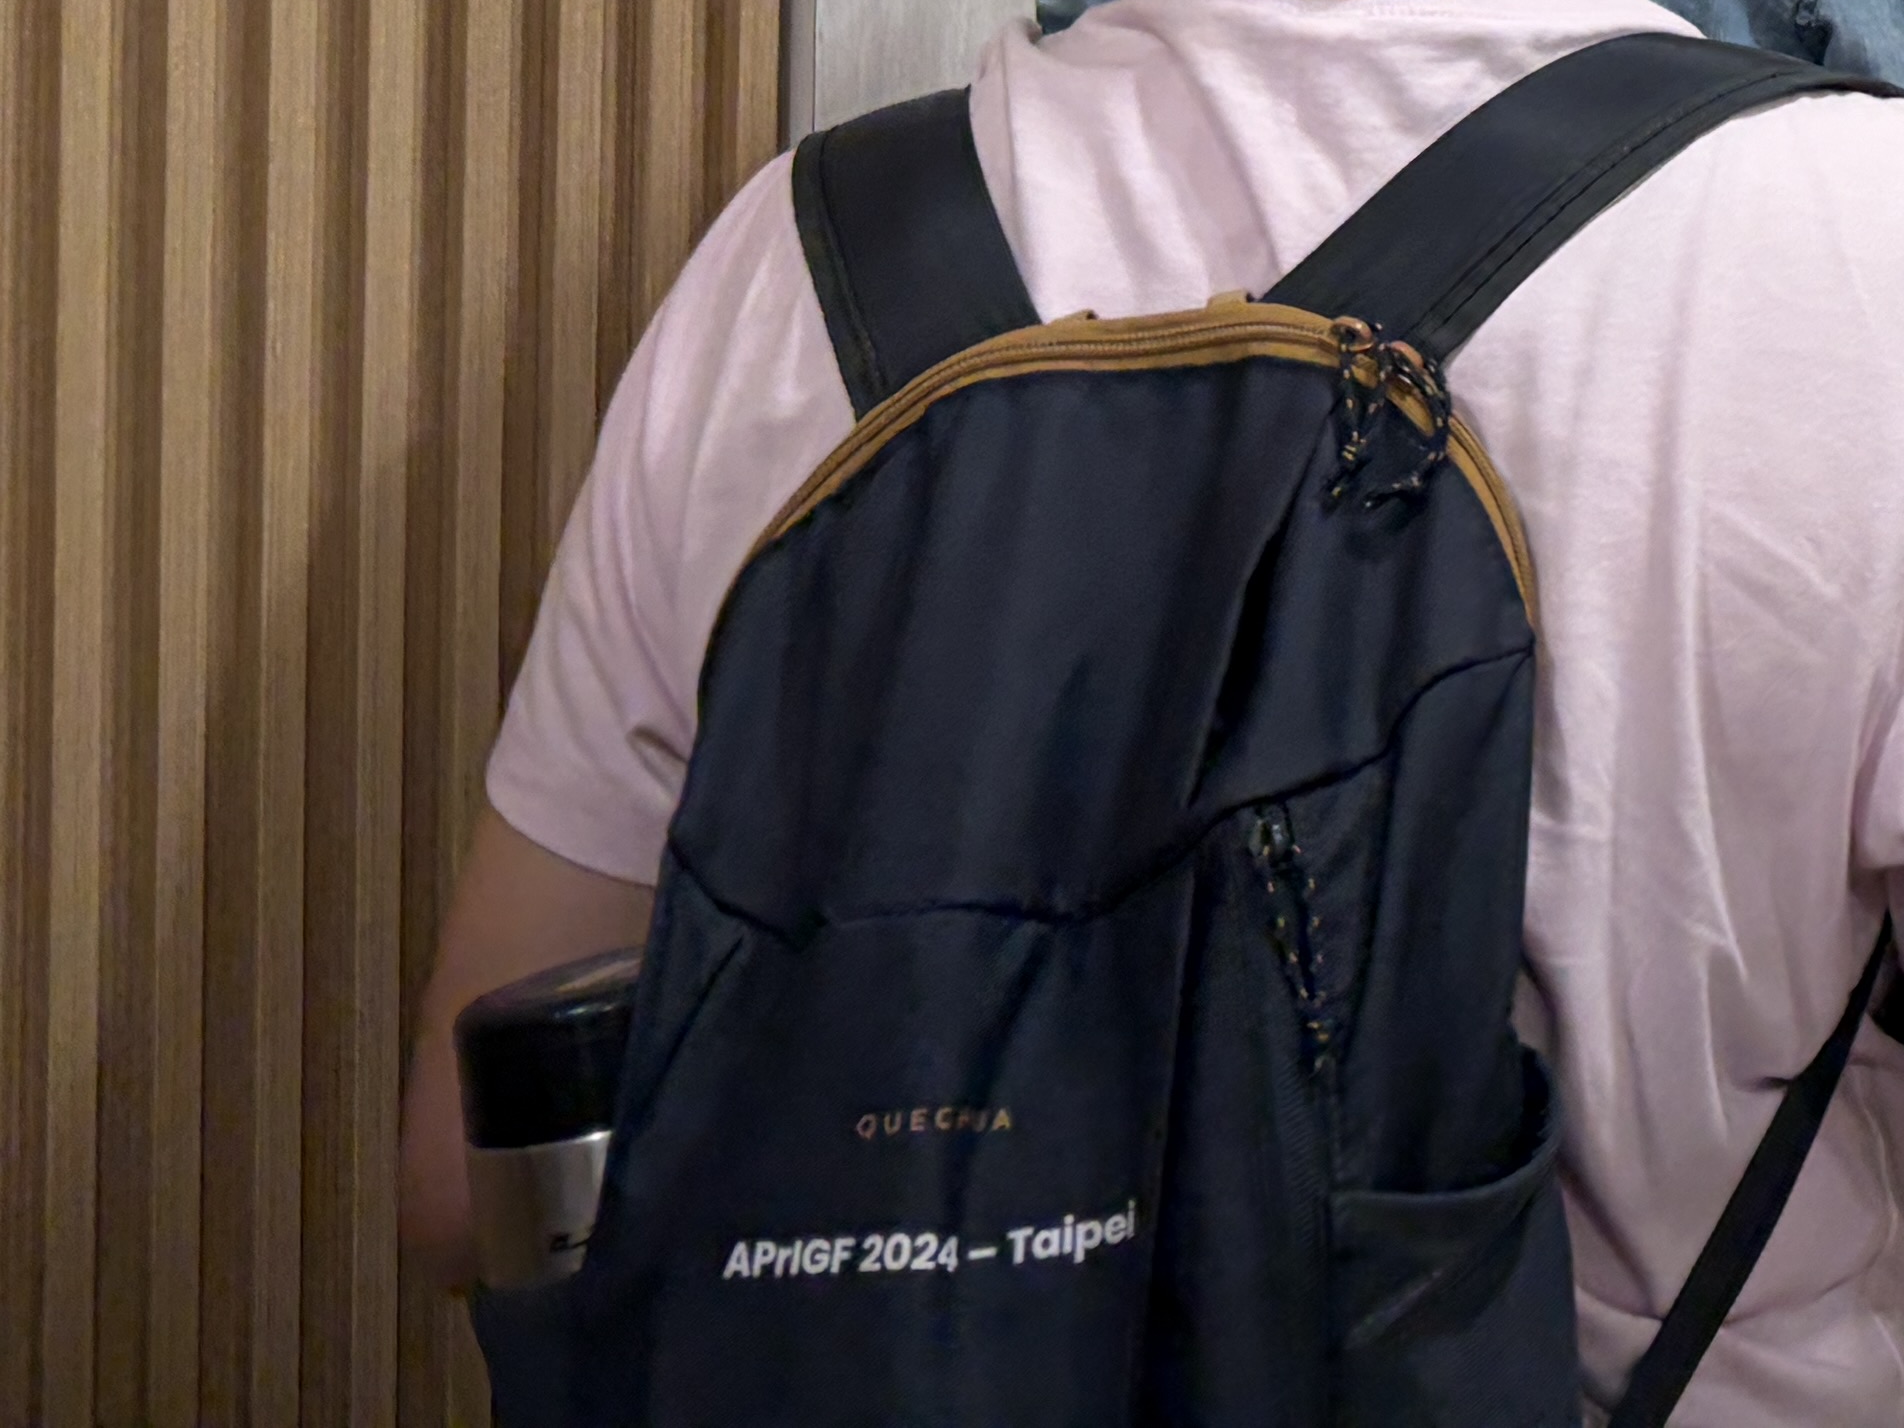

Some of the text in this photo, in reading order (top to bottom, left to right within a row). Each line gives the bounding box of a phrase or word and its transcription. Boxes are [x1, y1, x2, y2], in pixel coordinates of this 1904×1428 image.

[722, 1236, 855, 1280] APrIGF
[859, 1233, 960, 1273] 2024
[1008, 1197, 1138, 1265] Taipei
